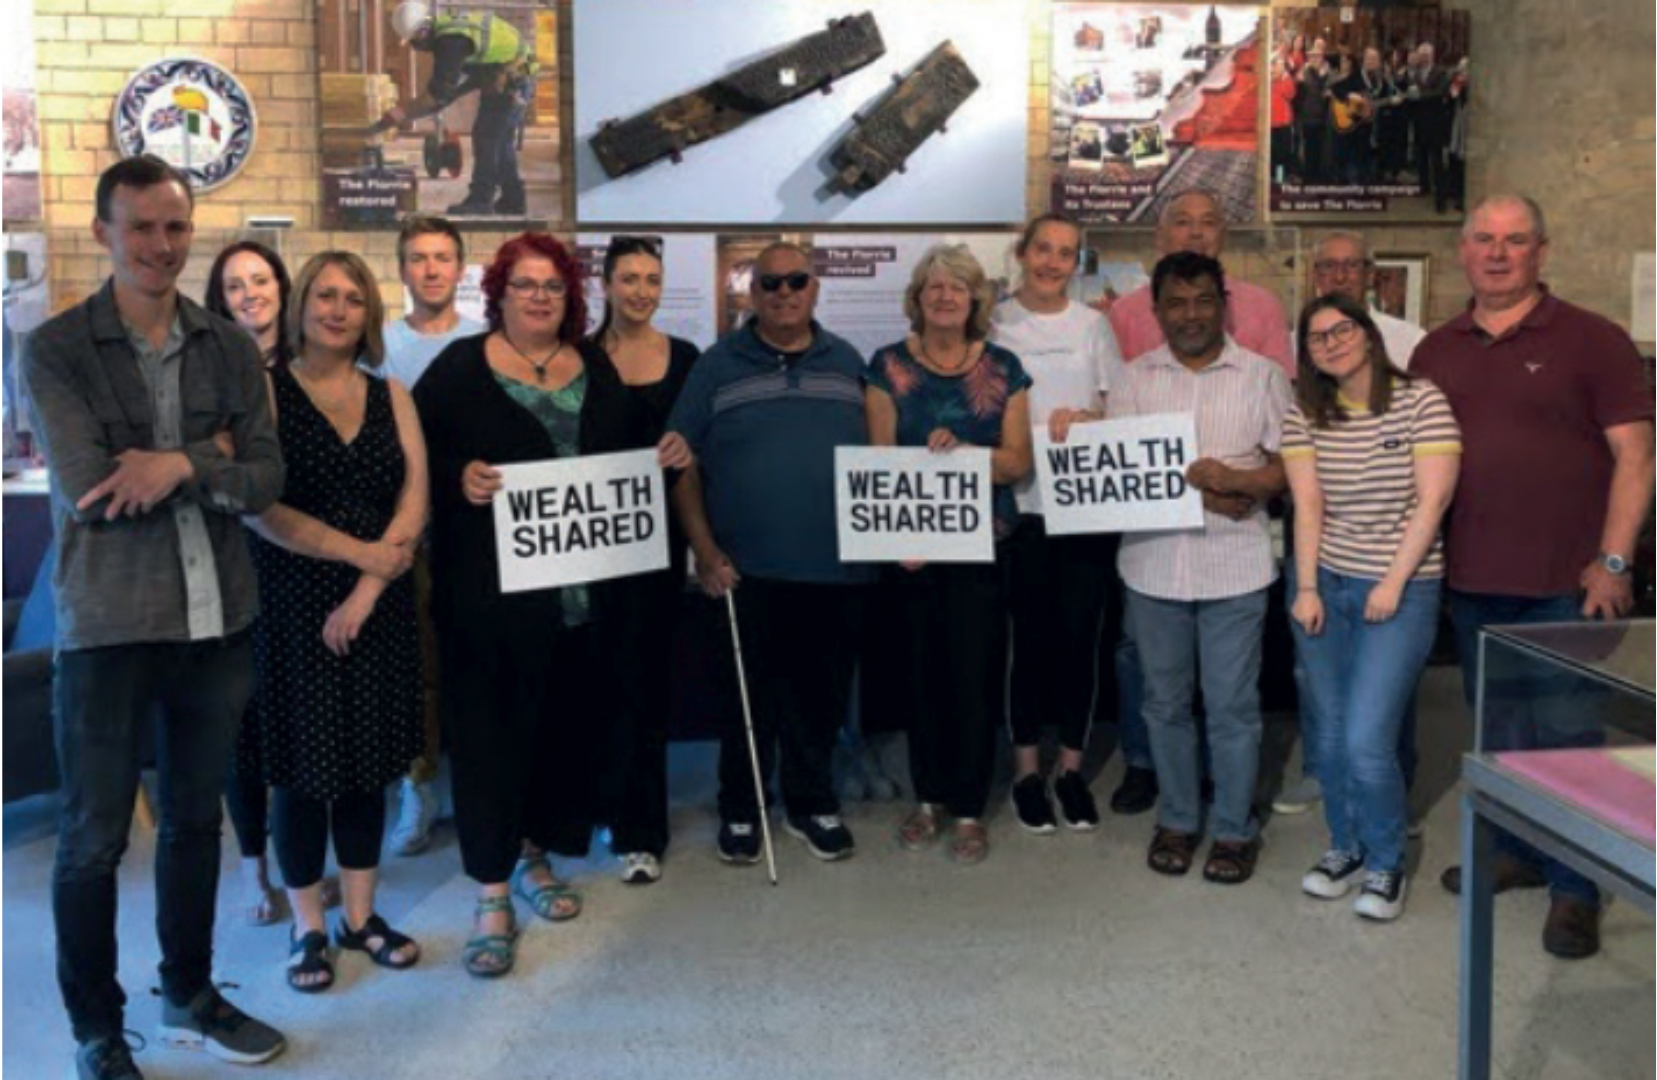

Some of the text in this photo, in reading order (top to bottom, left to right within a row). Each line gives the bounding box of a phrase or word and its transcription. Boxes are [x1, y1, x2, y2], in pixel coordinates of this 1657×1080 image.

[339, 179, 363, 190] The
[1065, 184, 1086, 195] The
[1130, 184, 1152, 195] and
[339, 194, 395, 207] restored
[1323, 200, 1343, 210] The
[828, 249, 848, 260] The
[1046, 435, 1184, 477] WEALTH
[506, 474, 652, 523] WEALTH
[847, 470, 979, 500] WEALTH
[1053, 468, 1187, 506] SHARED
[850, 503, 979, 533] SHARED
[512, 510, 654, 558] SHARED
